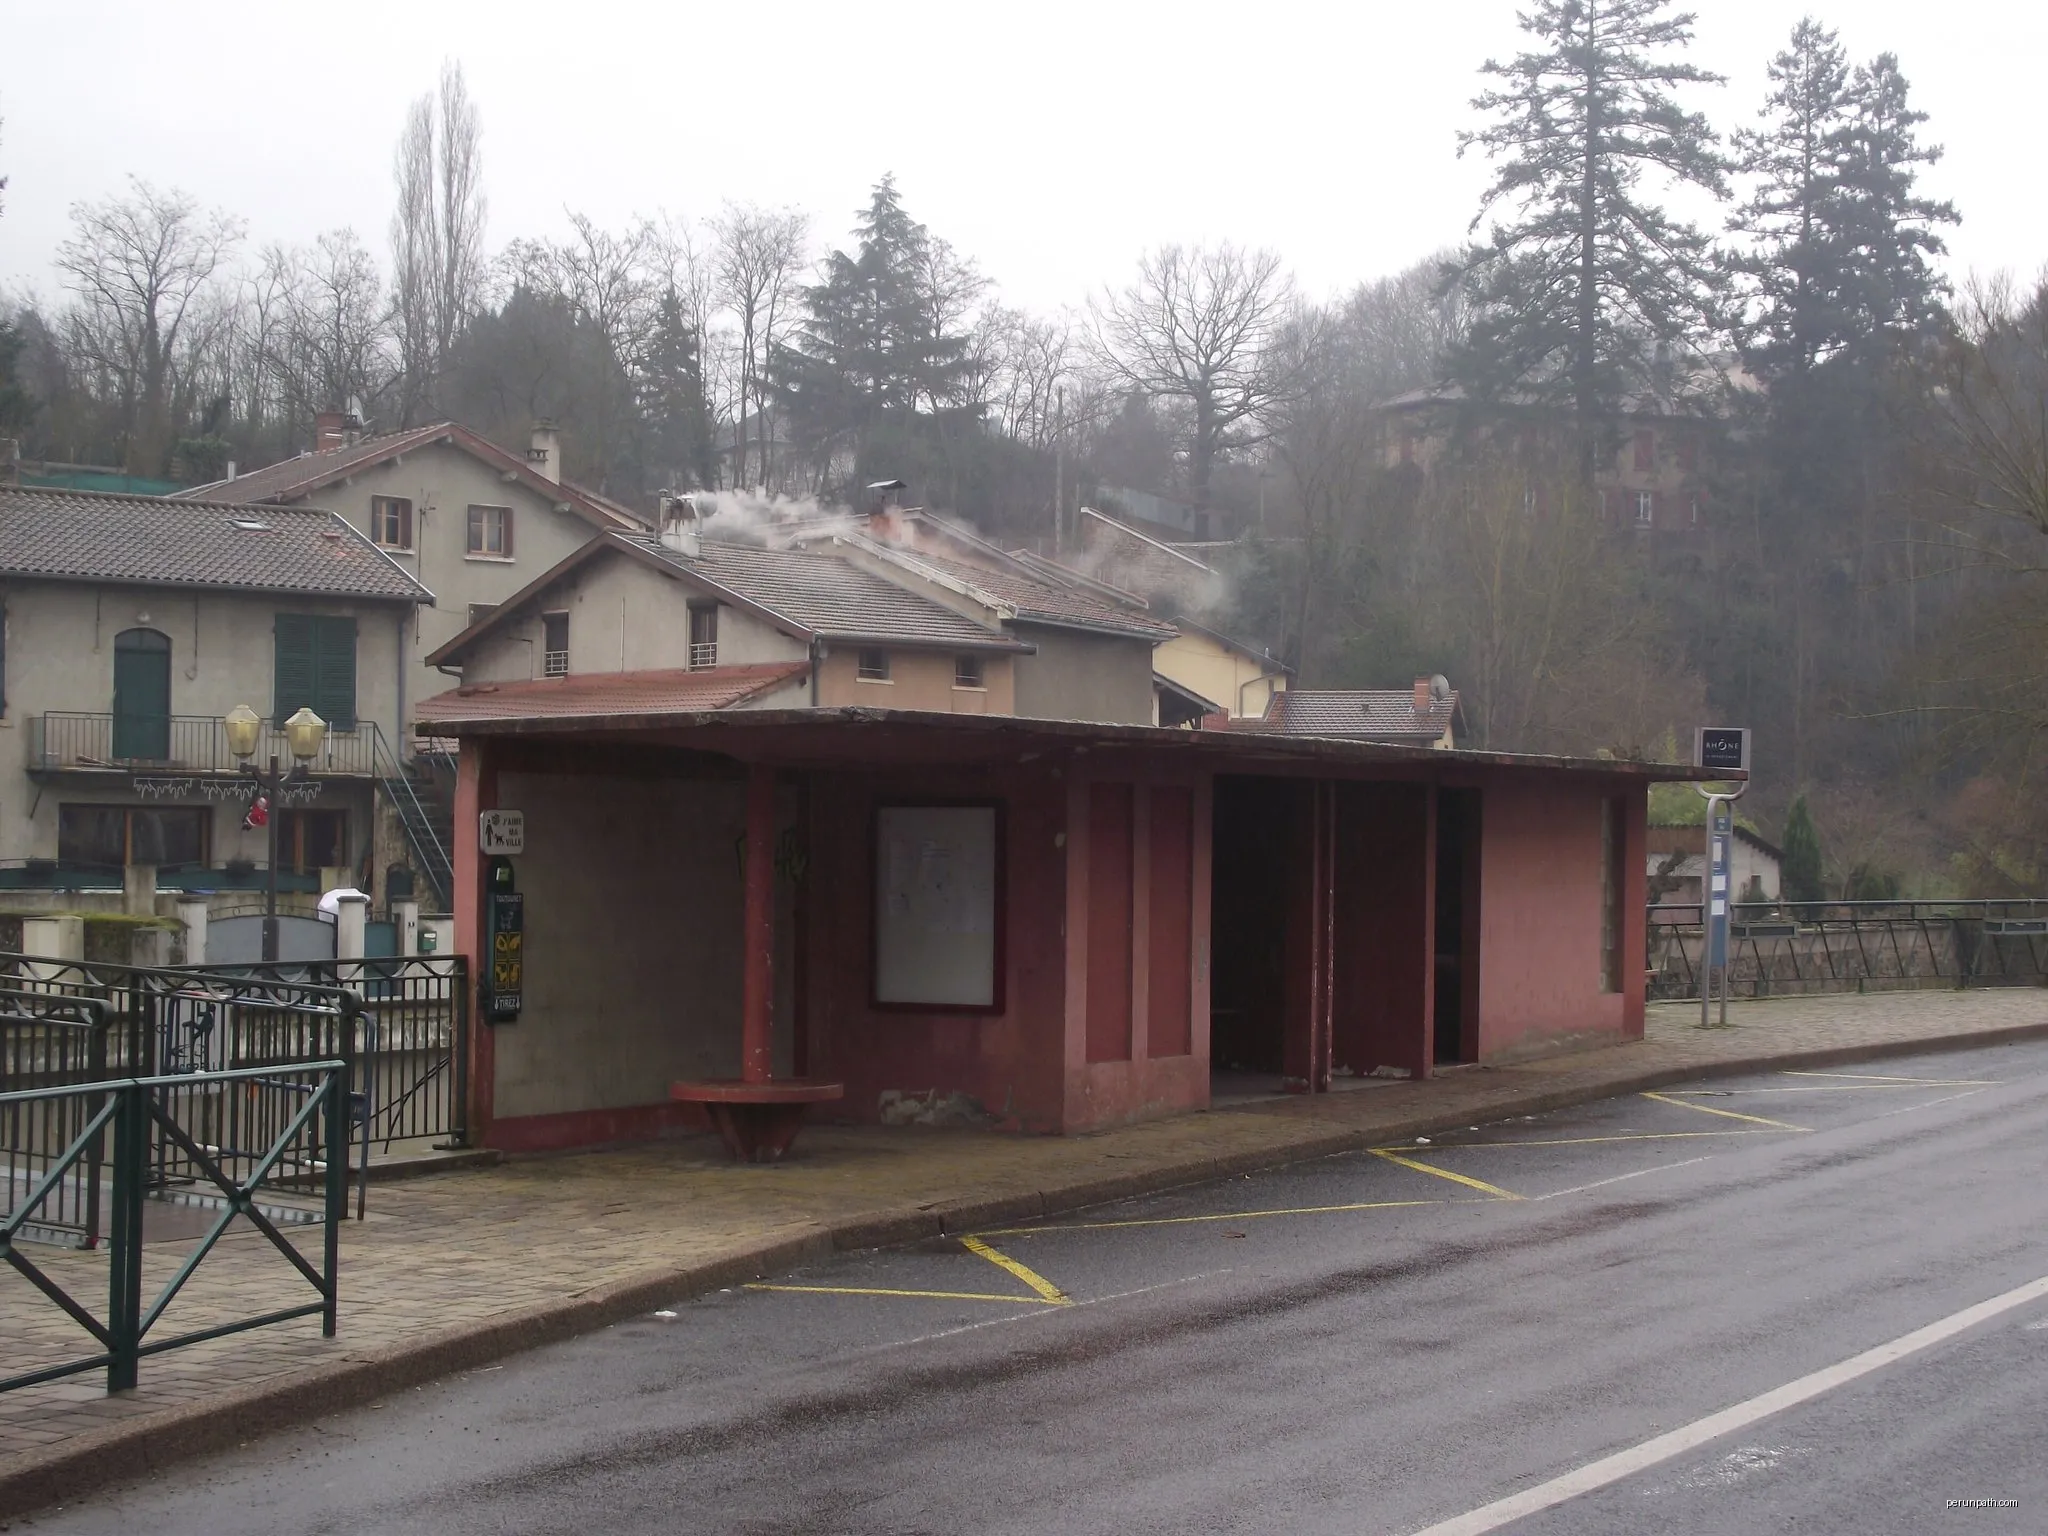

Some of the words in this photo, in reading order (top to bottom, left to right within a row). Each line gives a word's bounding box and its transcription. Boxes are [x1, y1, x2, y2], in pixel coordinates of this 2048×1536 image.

[503, 816, 523, 826] J'AIME
[508, 828, 519, 836] MA
[505, 838, 521, 847] VILLE
[499, 998, 516, 1010] TIREZ
